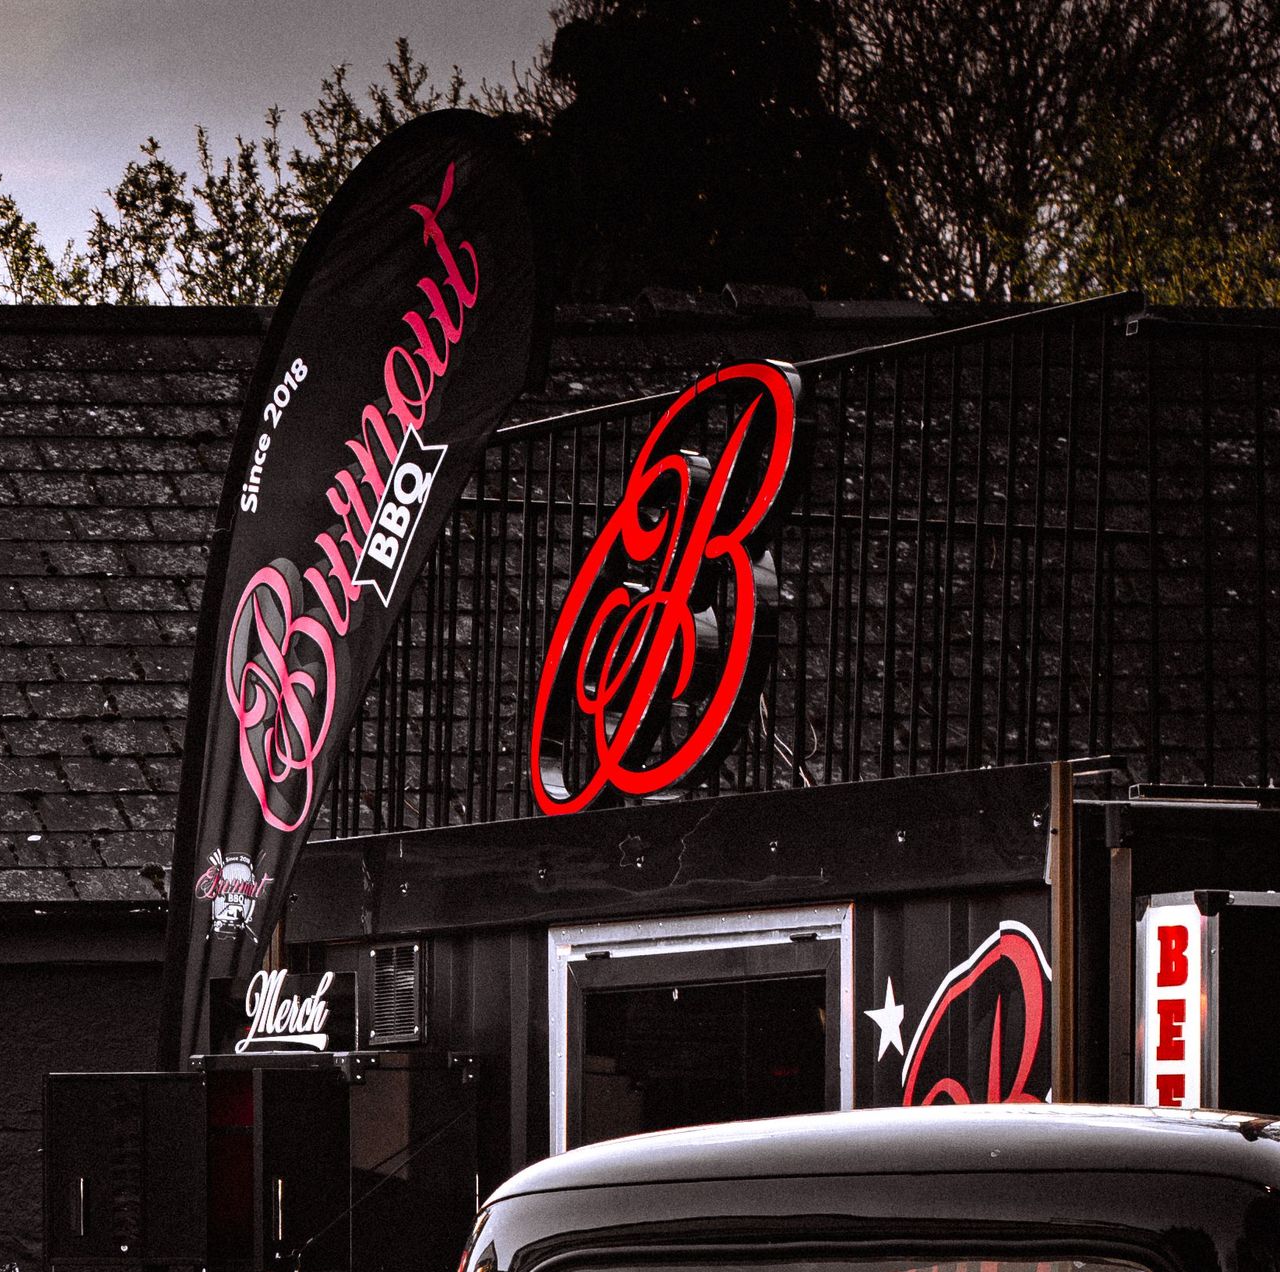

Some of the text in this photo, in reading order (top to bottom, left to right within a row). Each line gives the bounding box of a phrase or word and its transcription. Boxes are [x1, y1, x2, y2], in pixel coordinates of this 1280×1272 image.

[225, 162, 481, 833] Burnout
[240, 357, 309, 514] Since 2018
[368, 462, 433, 570] BBQ
[236, 968, 334, 1053] Merch
